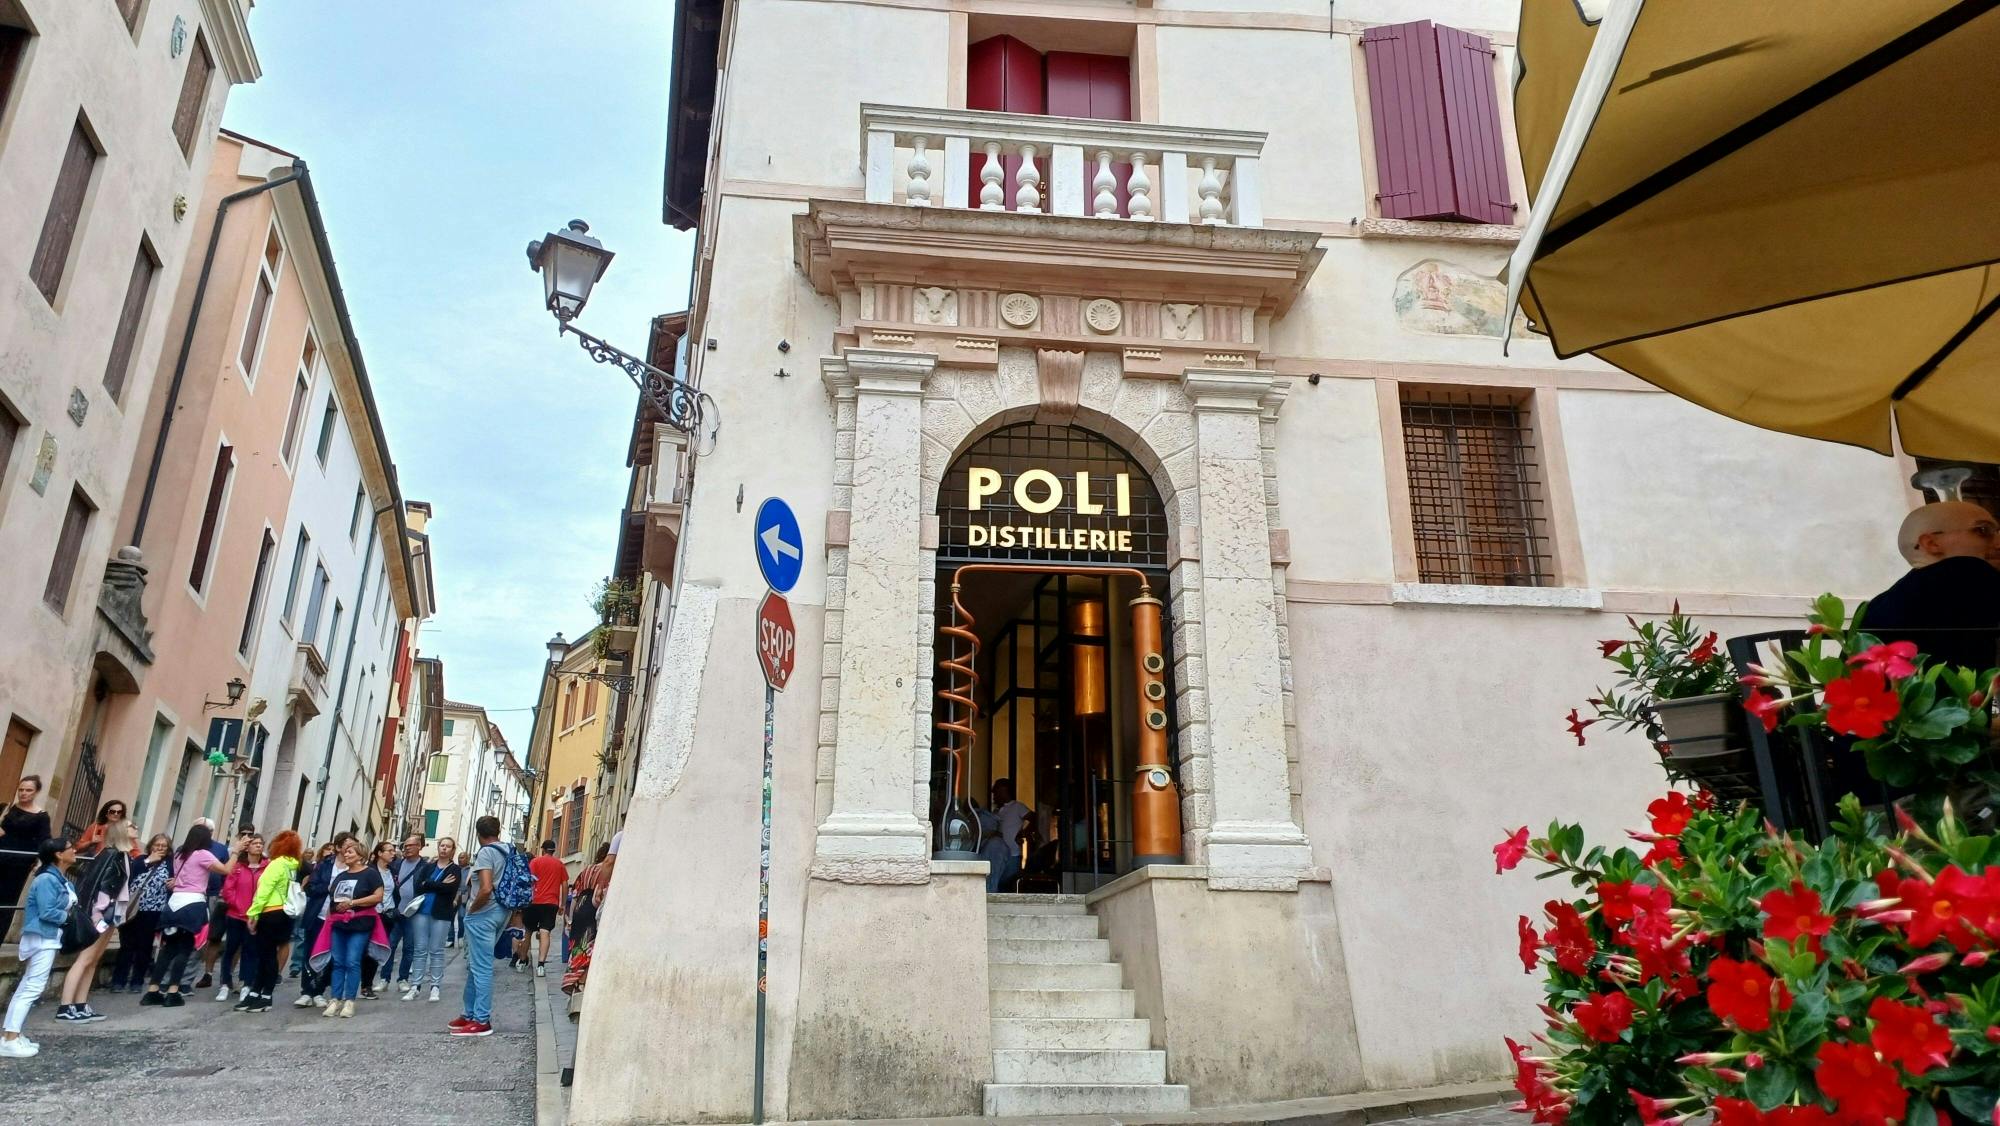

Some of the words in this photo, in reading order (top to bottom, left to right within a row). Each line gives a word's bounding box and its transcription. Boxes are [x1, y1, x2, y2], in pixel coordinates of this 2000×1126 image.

[968, 467, 1130, 517] POLI
[968, 524, 1133, 552] DISTILLERIE
[761, 617, 793, 662] STOP
[895, 677, 903, 688] 6
